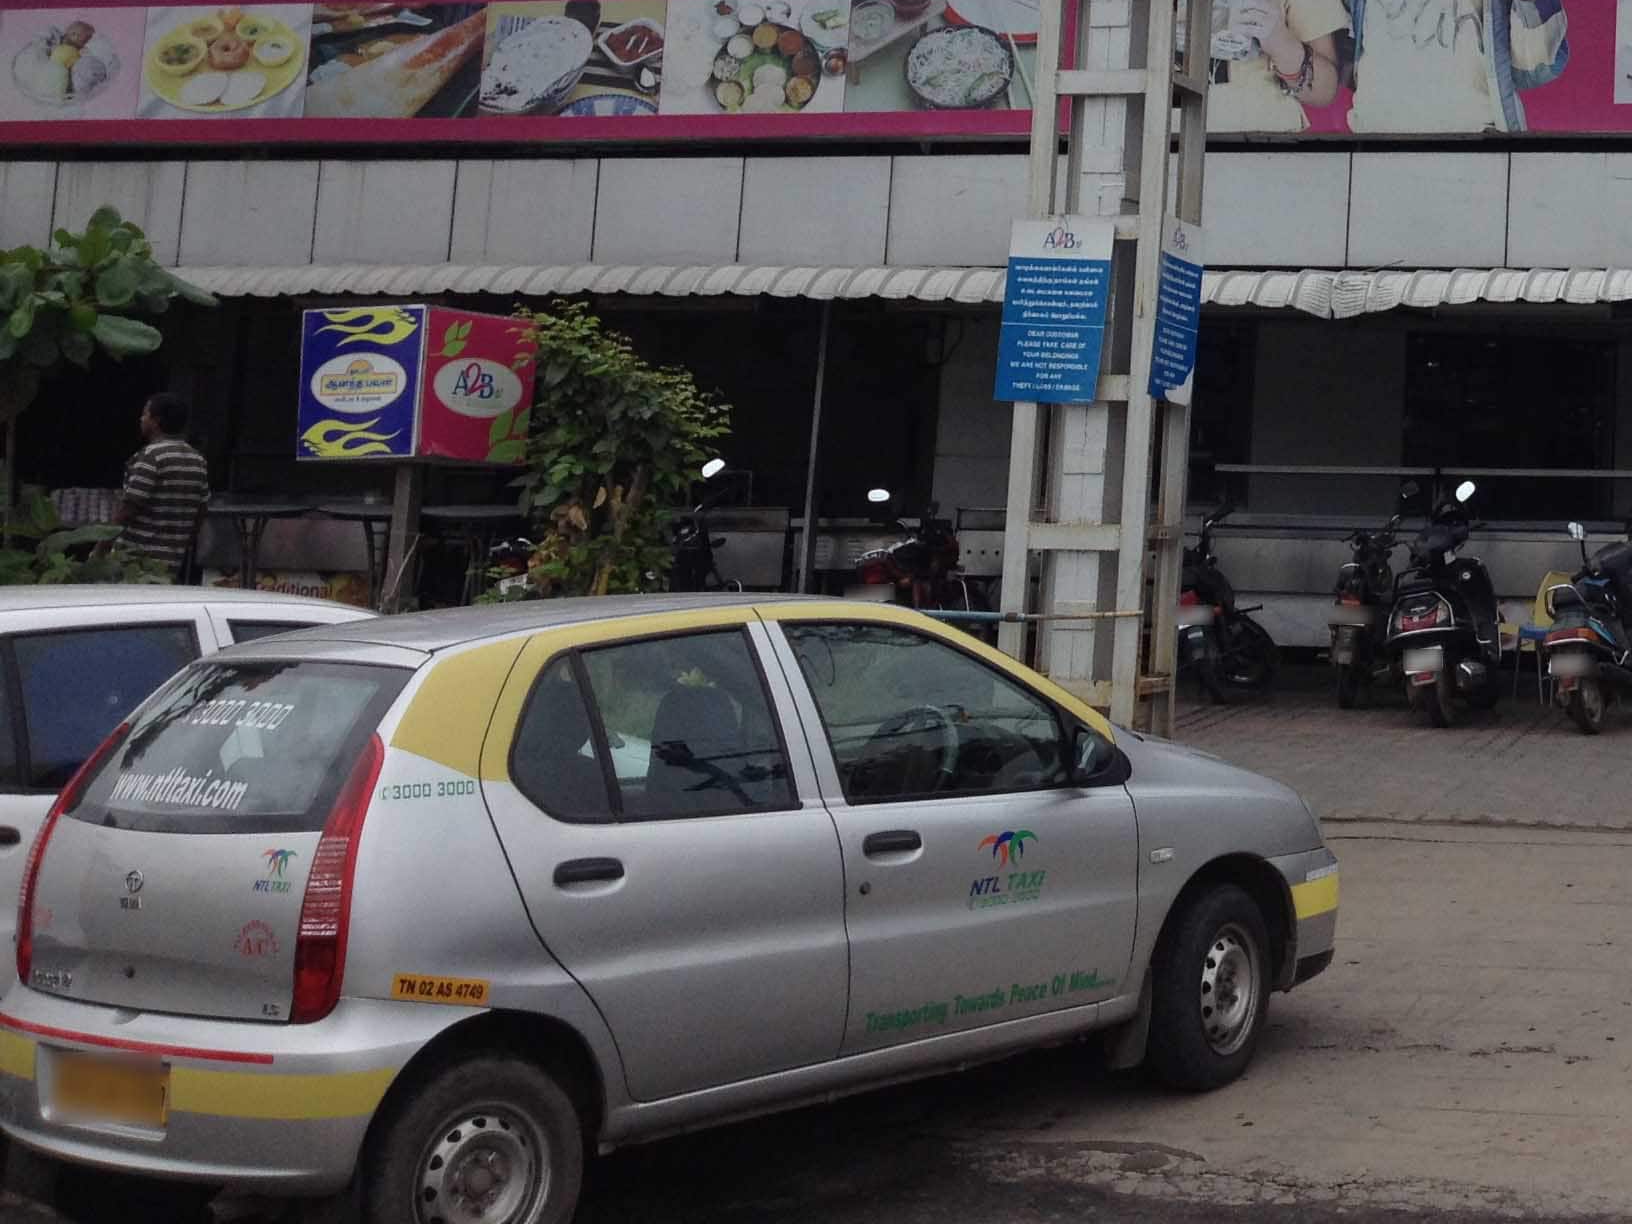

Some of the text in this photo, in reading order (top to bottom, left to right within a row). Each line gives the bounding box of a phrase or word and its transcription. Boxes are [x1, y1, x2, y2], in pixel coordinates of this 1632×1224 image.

[452, 362, 494, 399] A2B
[236, 701, 295, 730] 3000
[110, 766, 249, 810] www.ntltaxi.com
[392, 780, 474, 799] 3000 3000
[969, 871, 1047, 897] NTL TAXI
[398, 978, 484, 999] TN 02 AS 4749
